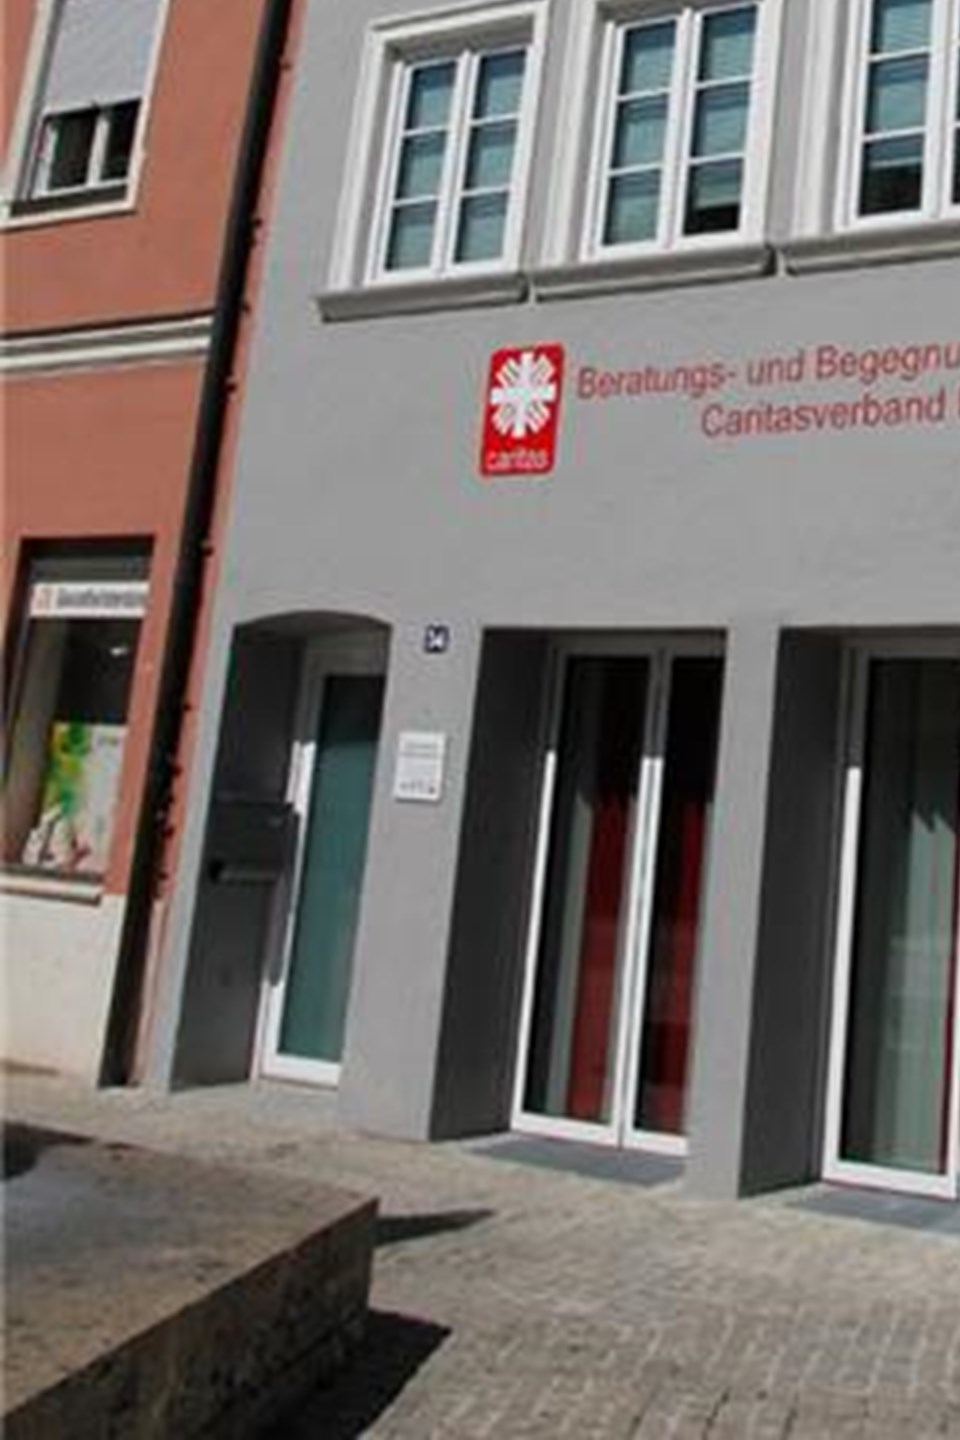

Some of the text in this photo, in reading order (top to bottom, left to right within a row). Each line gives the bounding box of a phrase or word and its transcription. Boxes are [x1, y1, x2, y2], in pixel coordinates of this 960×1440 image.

[577, 363, 736, 399] Beratungs-
[747, 348, 804, 386] und
[701, 386, 946, 438] Caritasverband
